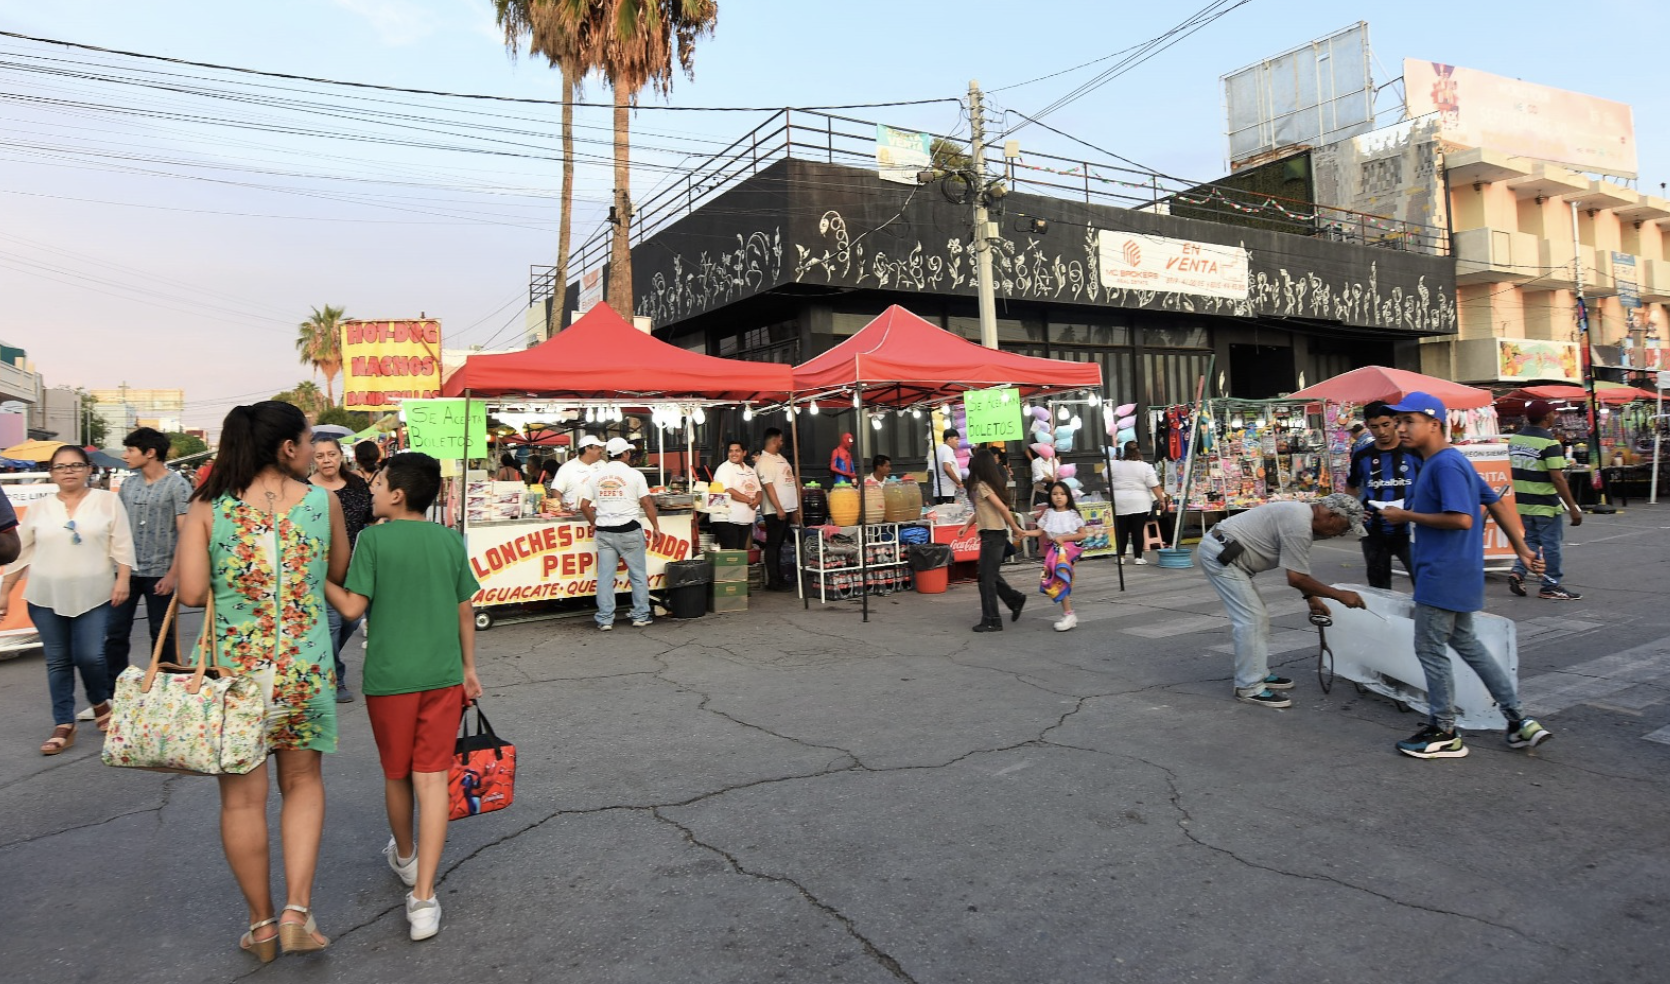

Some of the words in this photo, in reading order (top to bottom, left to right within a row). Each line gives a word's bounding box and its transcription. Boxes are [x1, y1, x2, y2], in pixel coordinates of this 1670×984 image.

[1182, 243, 1201, 255] EN
[1165, 257, 1217, 274] VENTA
[347, 322, 437, 345] HOT-DOG
[411, 406, 437, 424] SE
[968, 416, 1015, 437] BOLETOS
[411, 426, 474, 448] BOLETOS
[1367, 477, 1412, 489] digitalbits
[471, 525, 573, 578] LONCHES
[472, 583, 560, 603] AGUACATE
